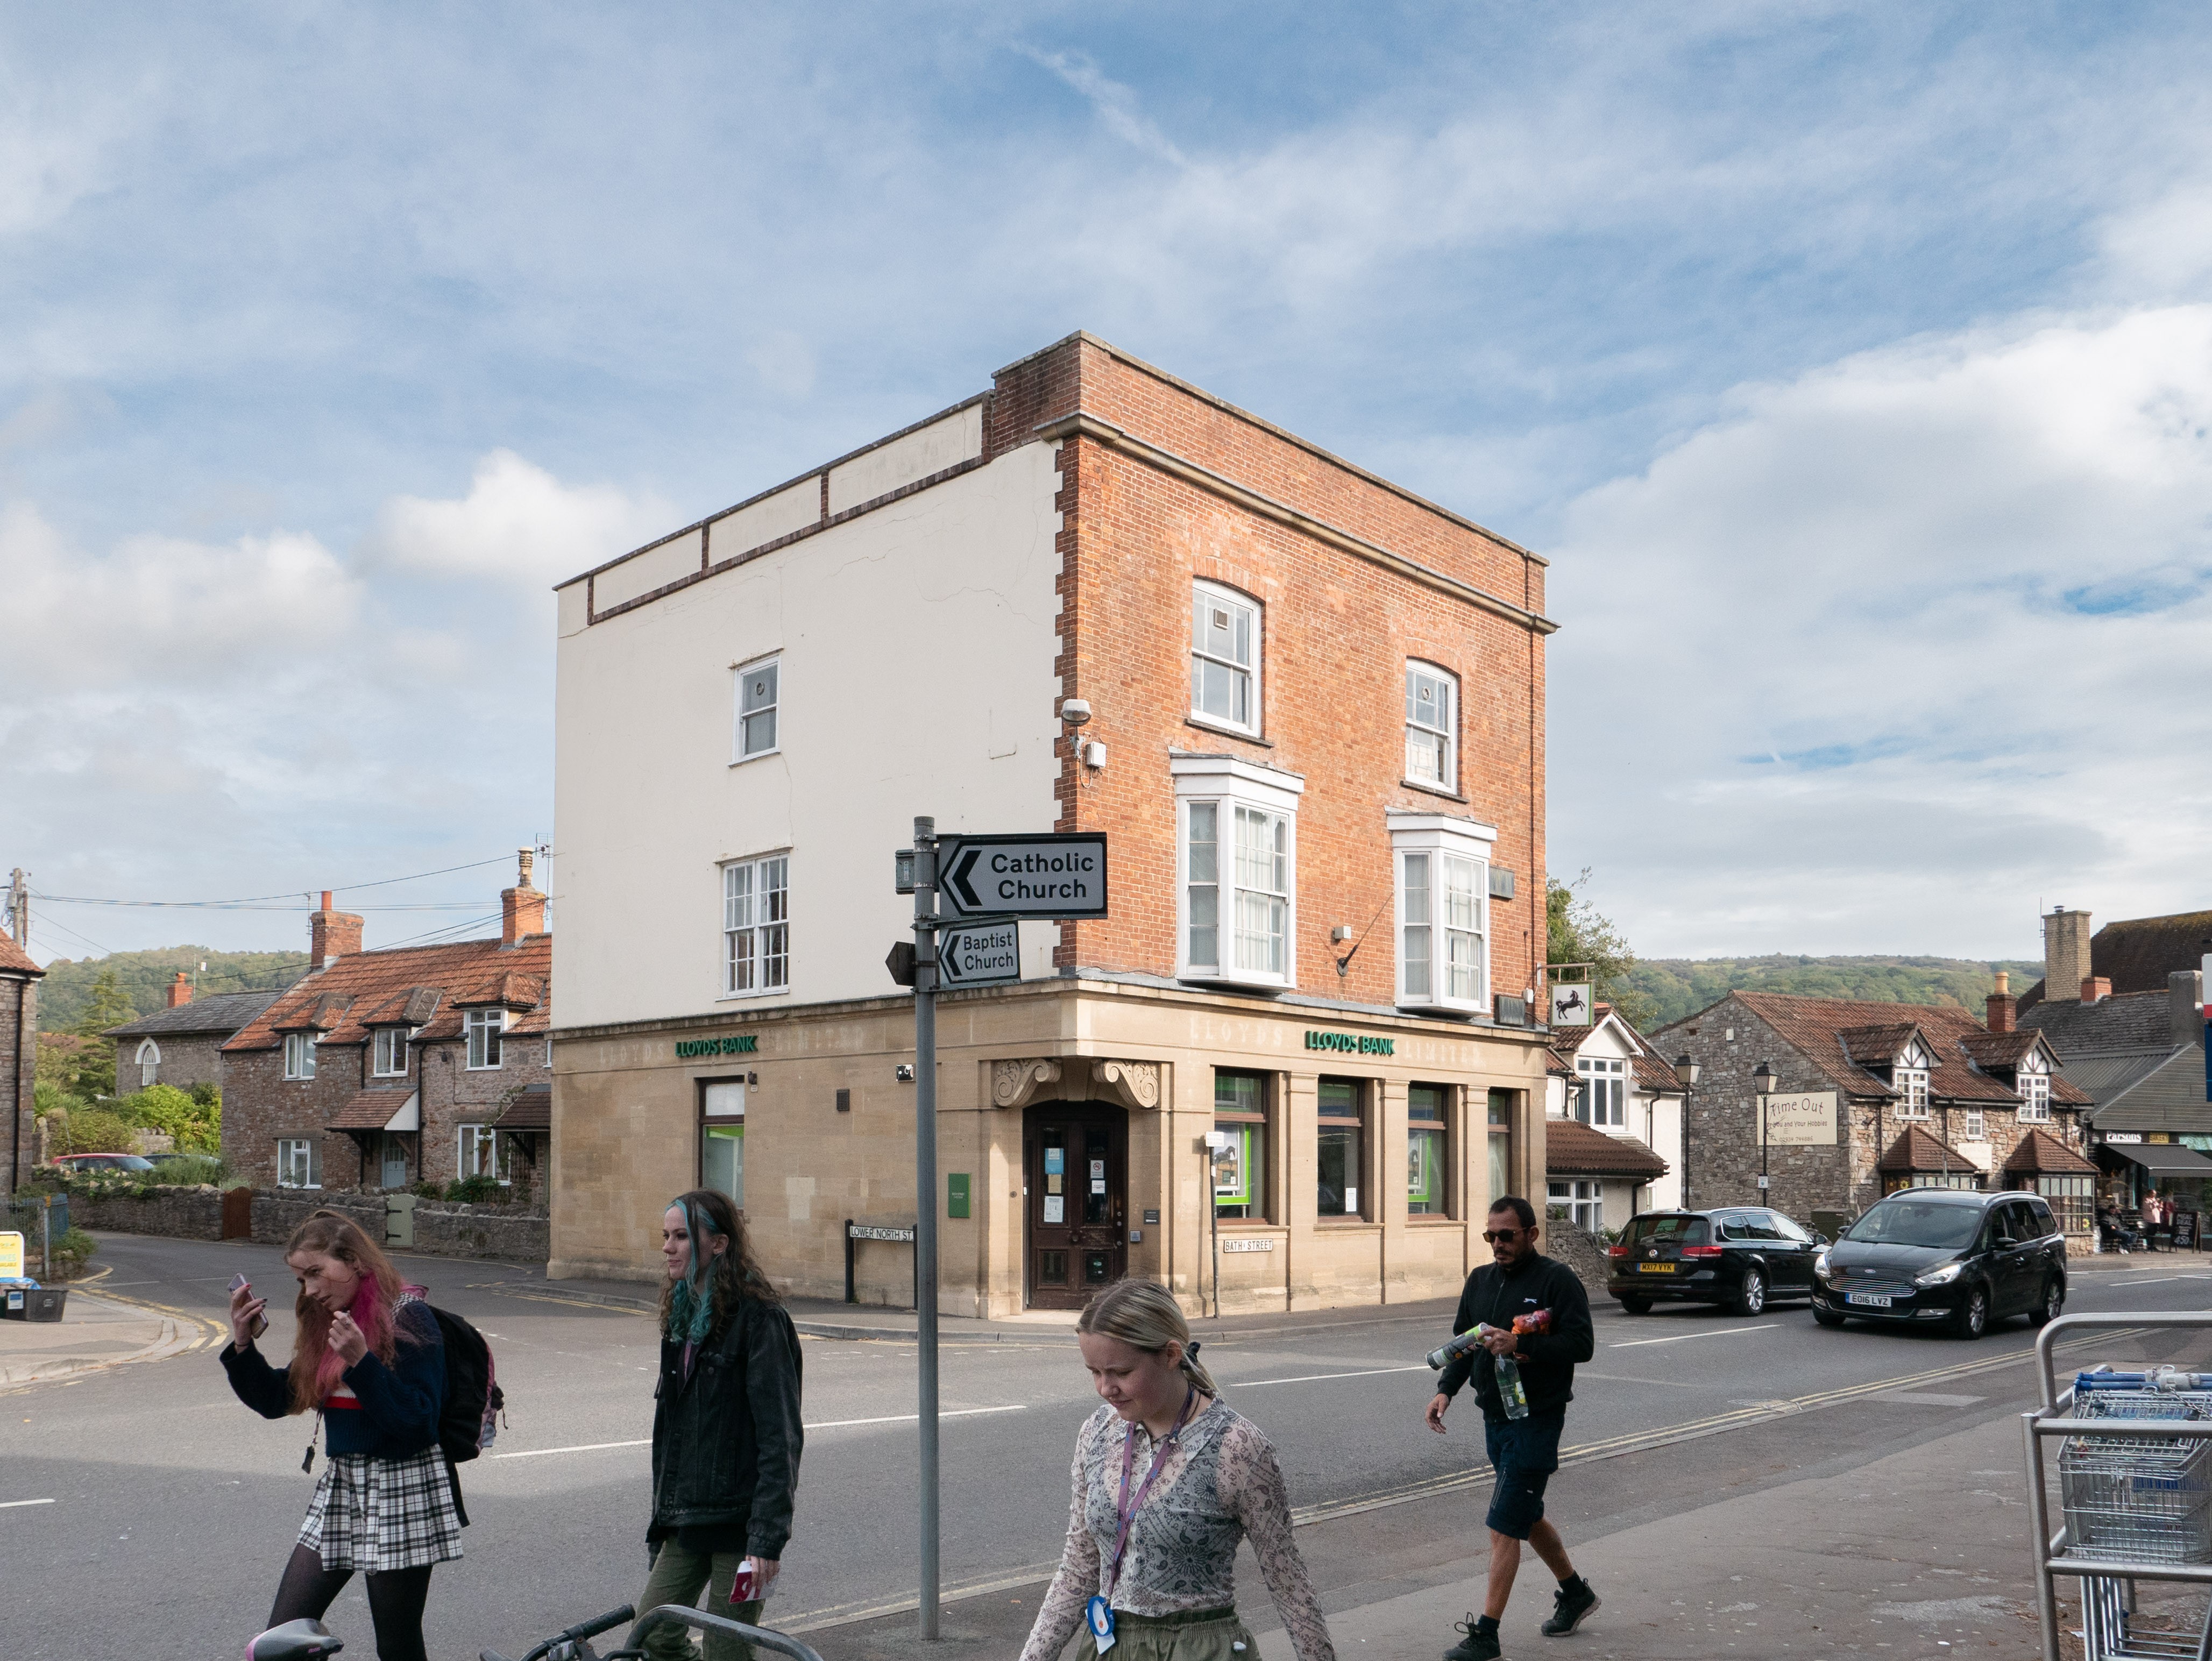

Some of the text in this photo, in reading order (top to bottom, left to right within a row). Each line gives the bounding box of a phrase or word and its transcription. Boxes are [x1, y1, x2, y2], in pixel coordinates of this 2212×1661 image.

[991, 853, 1094, 873] Catholic
[998, 879, 1087, 899] Church
[963, 932, 1012, 952] Baptist
[965, 953, 1013, 970] Church
[675, 1035, 757, 1056] LLOYDS BANK
[1307, 1031, 1395, 1054] LLOYDS BANK
[1770, 1098, 1824, 1116] Time Out
[2106, 1131, 2142, 1141] Parsons
[851, 1227, 874, 1237] LOWER
[876, 1229, 899, 1240] NORTH
[1225, 1240, 1272, 1251] BATH STREET
[1872, 1297, 1888, 1305] LVZ
